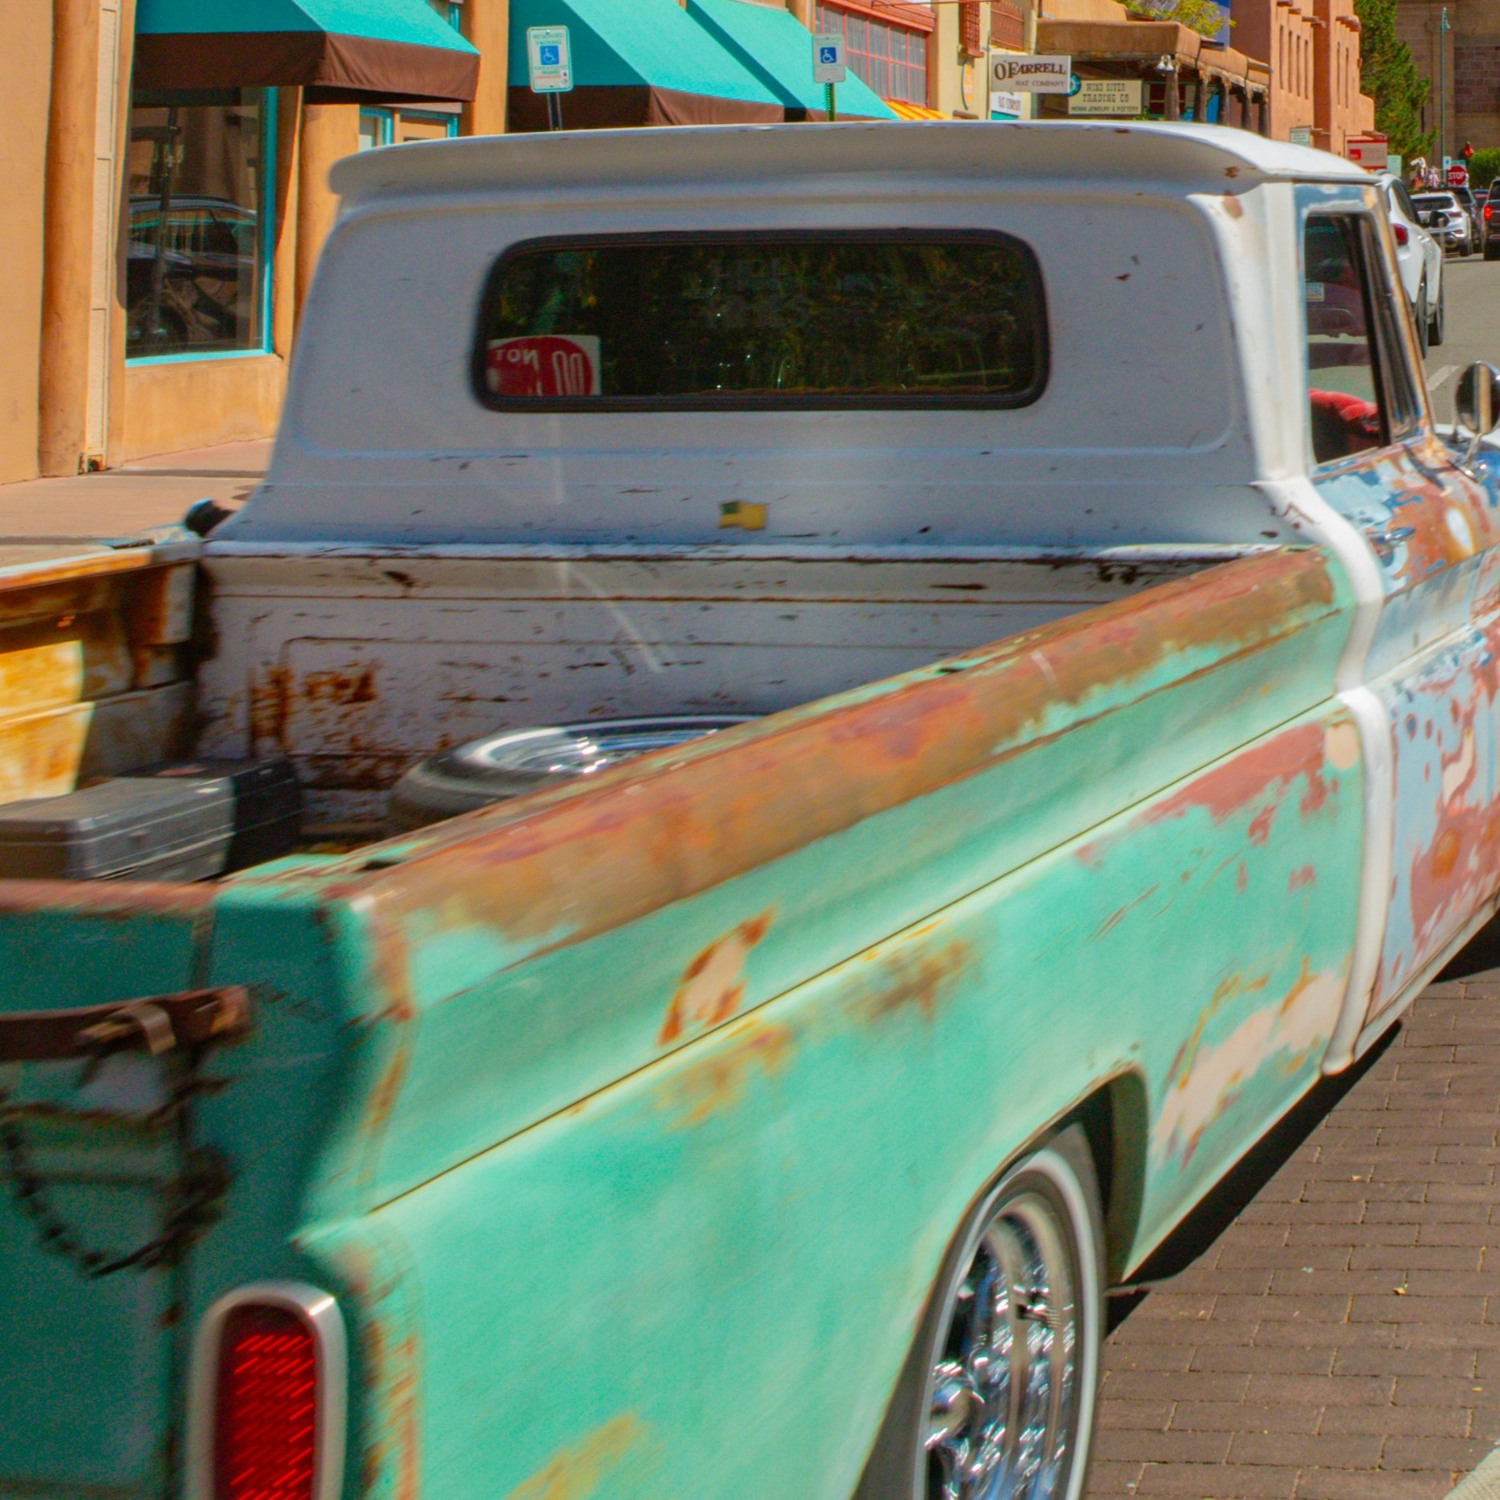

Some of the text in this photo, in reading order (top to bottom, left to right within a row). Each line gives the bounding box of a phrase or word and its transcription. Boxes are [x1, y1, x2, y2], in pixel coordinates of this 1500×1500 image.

[1106, 83, 1126, 91] RIVER
[1082, 94, 1117, 102] TRADING
[1447, 171, 1467, 180] STOP
